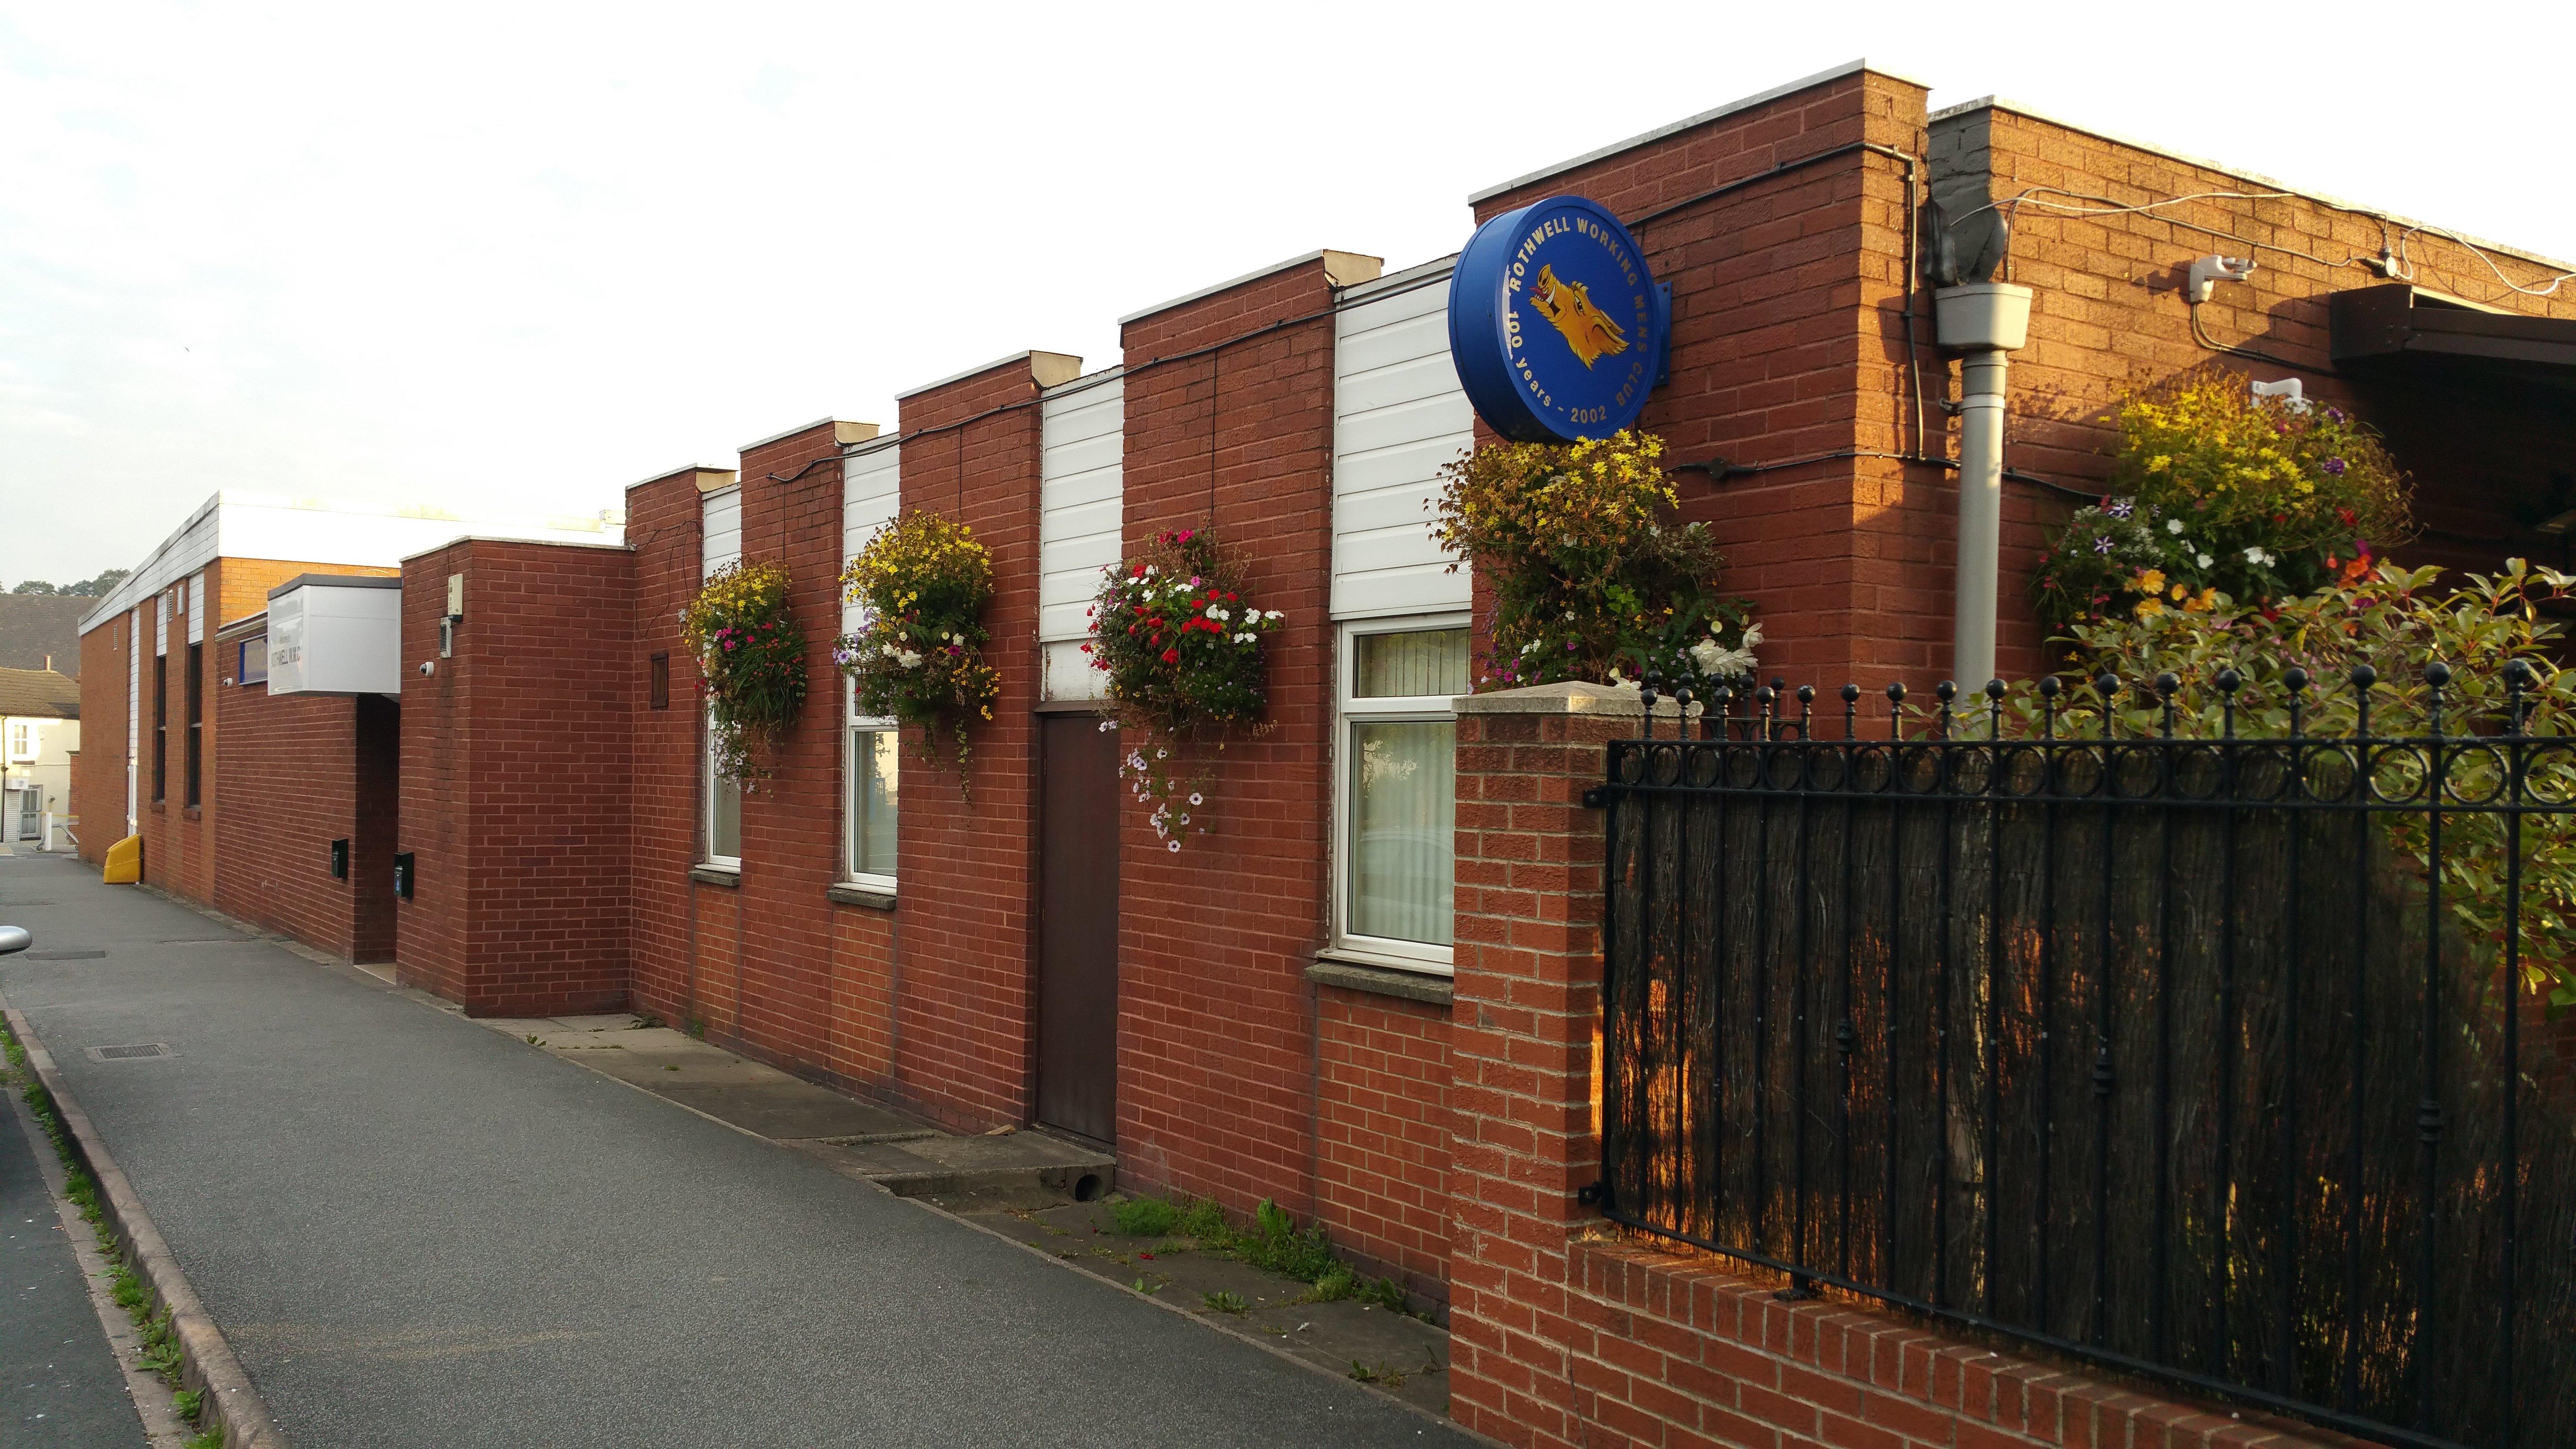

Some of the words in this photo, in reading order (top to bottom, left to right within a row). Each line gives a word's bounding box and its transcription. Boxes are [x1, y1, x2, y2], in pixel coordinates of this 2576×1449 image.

[1510, 217, 1570, 292] ROTHWELL
[1577, 217, 1637, 286] WORKING
[1634, 295, 1647, 353] MENS
[1508, 311, 1523, 348] 100
[1516, 357, 1551, 407] years
[1571, 405, 1607, 424] 2002
[1616, 362, 1643, 407] CLUB
